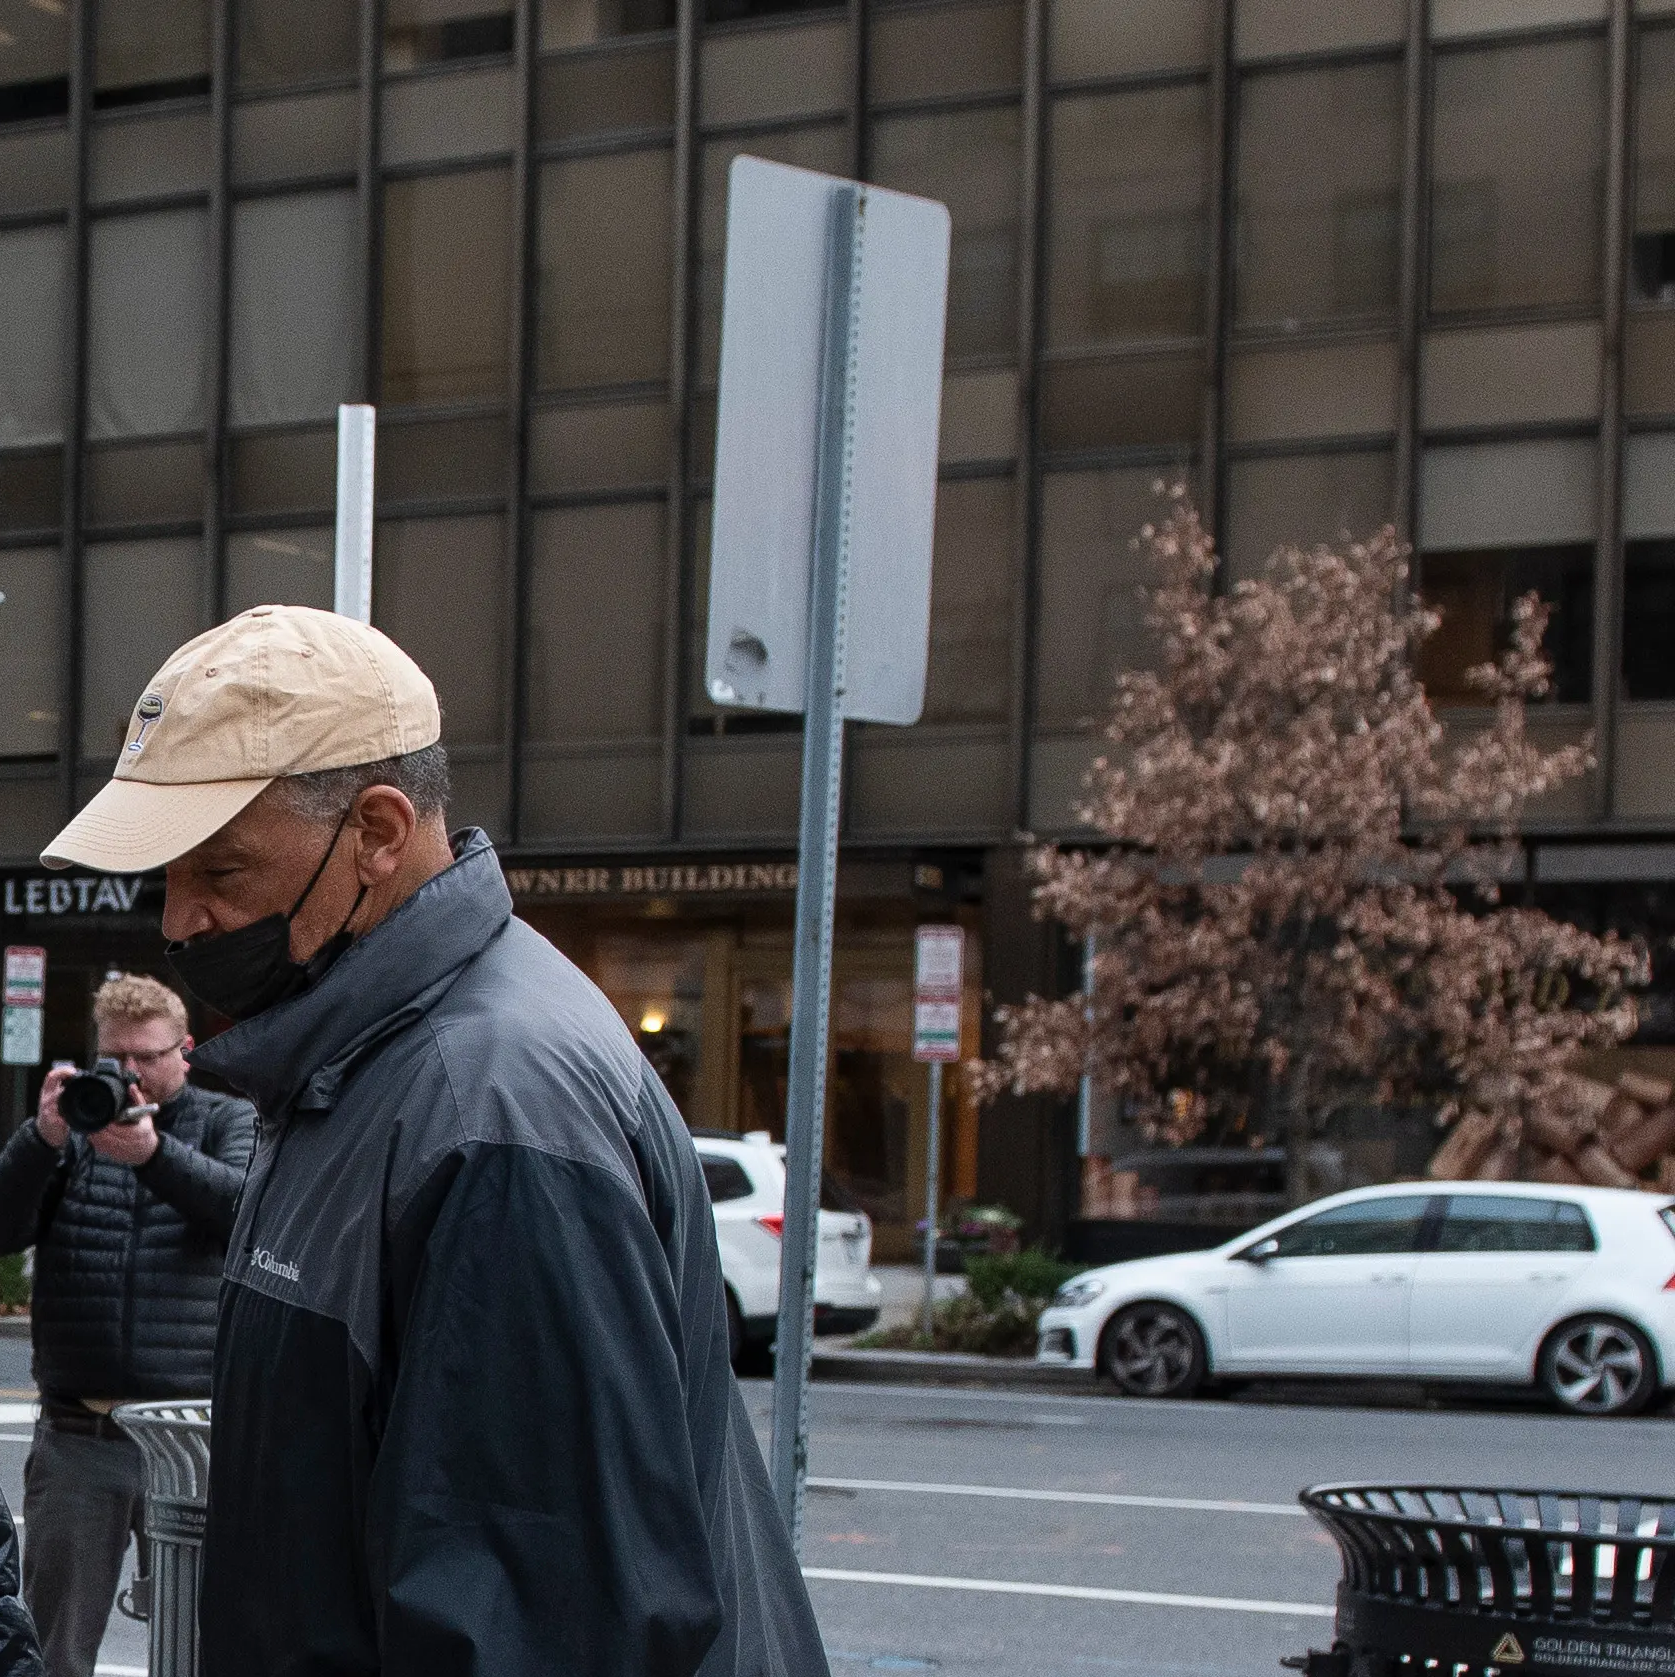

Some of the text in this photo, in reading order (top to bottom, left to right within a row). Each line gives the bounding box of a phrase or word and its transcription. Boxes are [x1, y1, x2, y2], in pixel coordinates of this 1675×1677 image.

[508, 863, 798, 893] WNER BUILDING
[1533, 1636, 1675, 1662] GOLDEN TRIANGL
